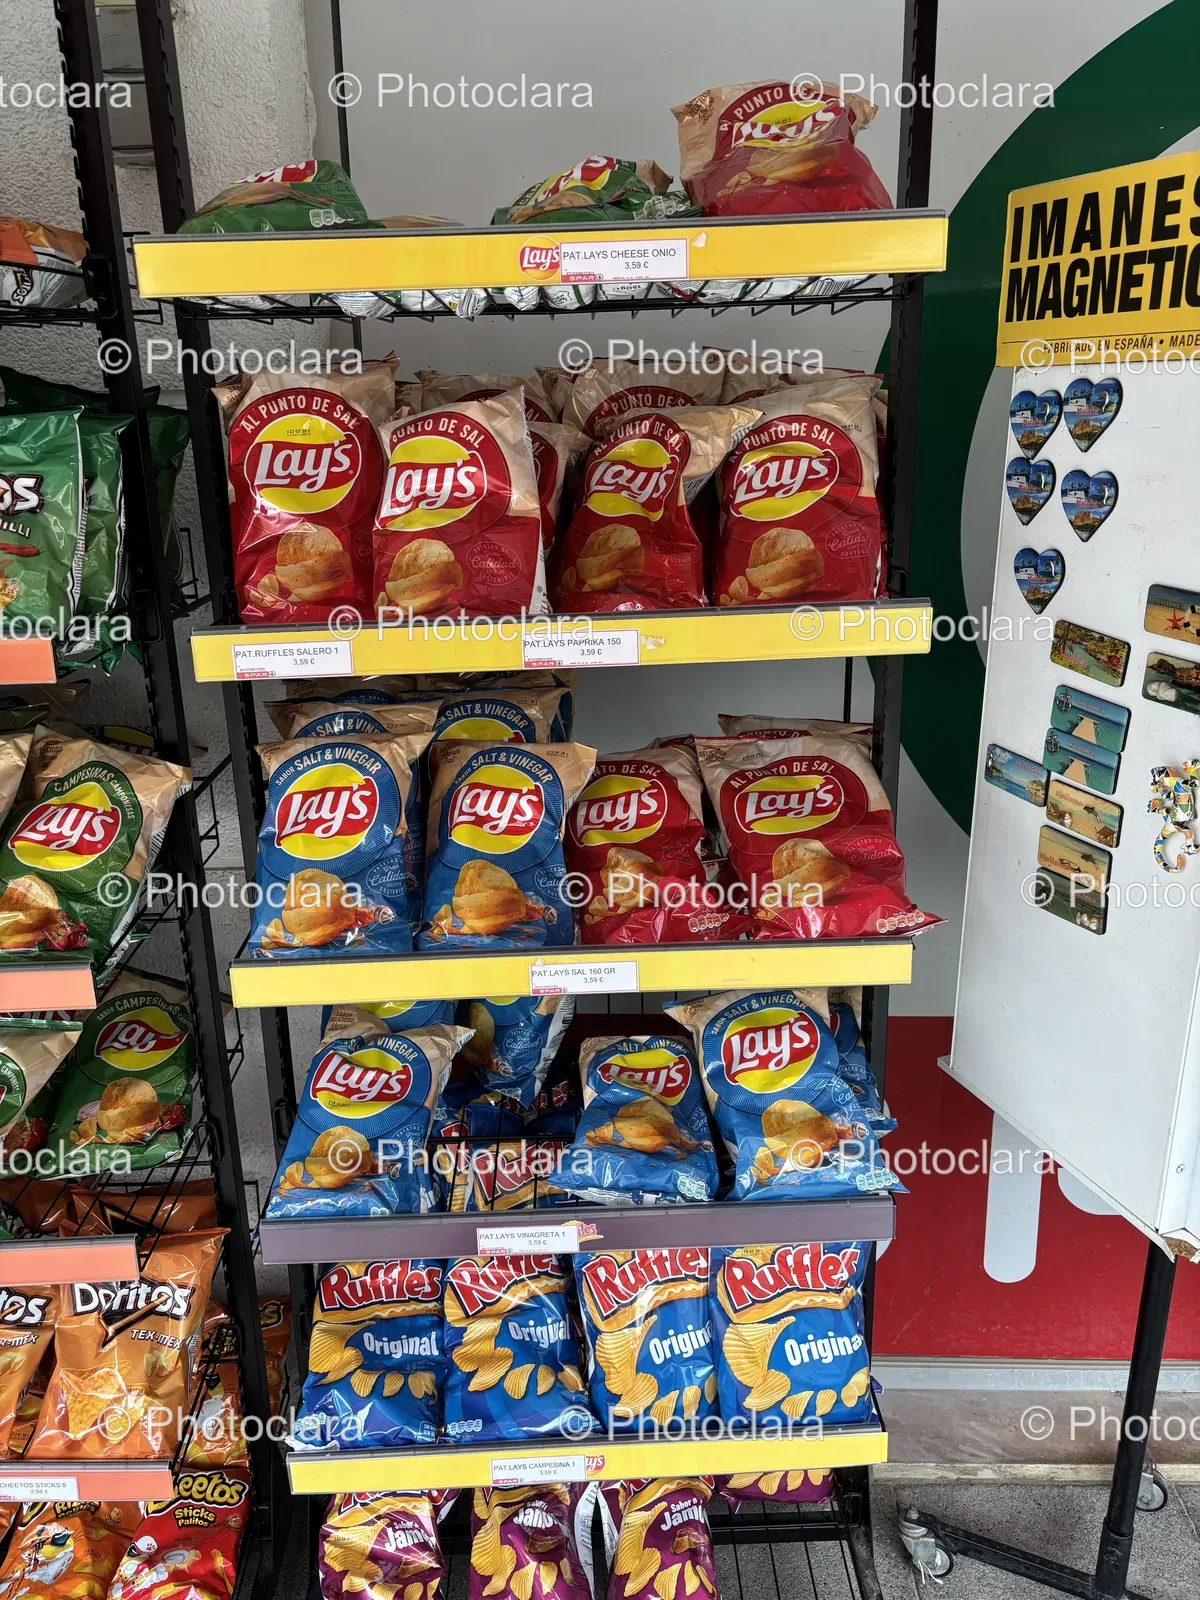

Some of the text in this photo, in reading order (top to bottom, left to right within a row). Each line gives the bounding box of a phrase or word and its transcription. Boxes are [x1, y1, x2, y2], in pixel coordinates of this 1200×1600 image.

[733, 87, 783, 120] PUNTO
[523, 247, 560, 270] Lay's
[563, 248, 676, 260] PAT.LAYS CHEESE ONIO
[624, 261, 641, 270] 3,59
[1114, 335, 1153, 349] ESPAÑA
[240, 395, 357, 433] AL PUNTO DE SAL
[611, 393, 673, 415] PUNTO DE
[439, 417, 457, 433] DE
[460, 425, 485, 449] SAL
[610, 420, 684, 452] PUNTO DE SAL
[744, 422, 835, 450] PUNTO DE SAL
[253, 439, 353, 493] Lay's
[733, 453, 829, 504] Lay's
[380, 459, 477, 513] Lay's
[591, 462, 675, 504] Lay's
[469, 557, 517, 568] Calidad
[235, 648, 295, 658] PAT.RUFFLES
[296, 647, 332, 655] SALERO
[525, 640, 565, 648] PAT.LAYS
[567, 638, 604, 646] PAPRIKA
[293, 658, 309, 666] 3,59
[447, 703, 529, 729] SALT & VINEGAR
[1077, 700, 1105, 714] MALLORCA
[275, 766, 295, 786] SABOR
[294, 750, 322, 771] SALT
[324, 748, 333, 760] &
[335, 748, 382, 775] VINEGAR
[471, 752, 495, 770] SALT
[498, 752, 507, 762] &
[509, 752, 553, 783] VINEGAR
[621, 764, 661, 777] DE SAL
[729, 760, 837, 789] AL PUNTO DE SAL
[54, 766, 135, 820] CAMPESINAS CAMPONESAS
[745, 784, 834, 823] Lay's
[281, 784, 372, 838] Lay's
[453, 784, 539, 834] Lay's
[576, 787, 659, 833] Lay's
[16, 804, 115, 851] Lay's
[532, 969, 569, 977] PAT.LAYS
[97, 997, 180, 1020] SABOR CAMPESINAS
[724, 1002, 749, 1020] SALT
[751, 1000, 759, 1010] &
[760, 994, 807, 1010] VINEGAR
[377, 1037, 418, 1062] VINEGAR
[505, 1037, 540, 1049] Calidad
[731, 1018, 811, 1075] Lay's
[316, 1055, 407, 1102] Lay's
[516, 1231, 560, 1239] VINAGRETA
[320, 1259, 442, 1310] Ruffles
[725, 1243, 860, 1309] Ruffles
[74, 1282, 192, 1318] Doritos
[131, 1330, 183, 1350] TEX-MEX
[363, 1331, 439, 1358] Original
[508, 1314, 570, 1348] Original
[529, 1462, 571, 1470] CAMPESINA
[175, 1506, 216, 1522] Sticks
[671, 1499, 691, 1513] Sabor
[178, 1517, 210, 1527] Palitos
